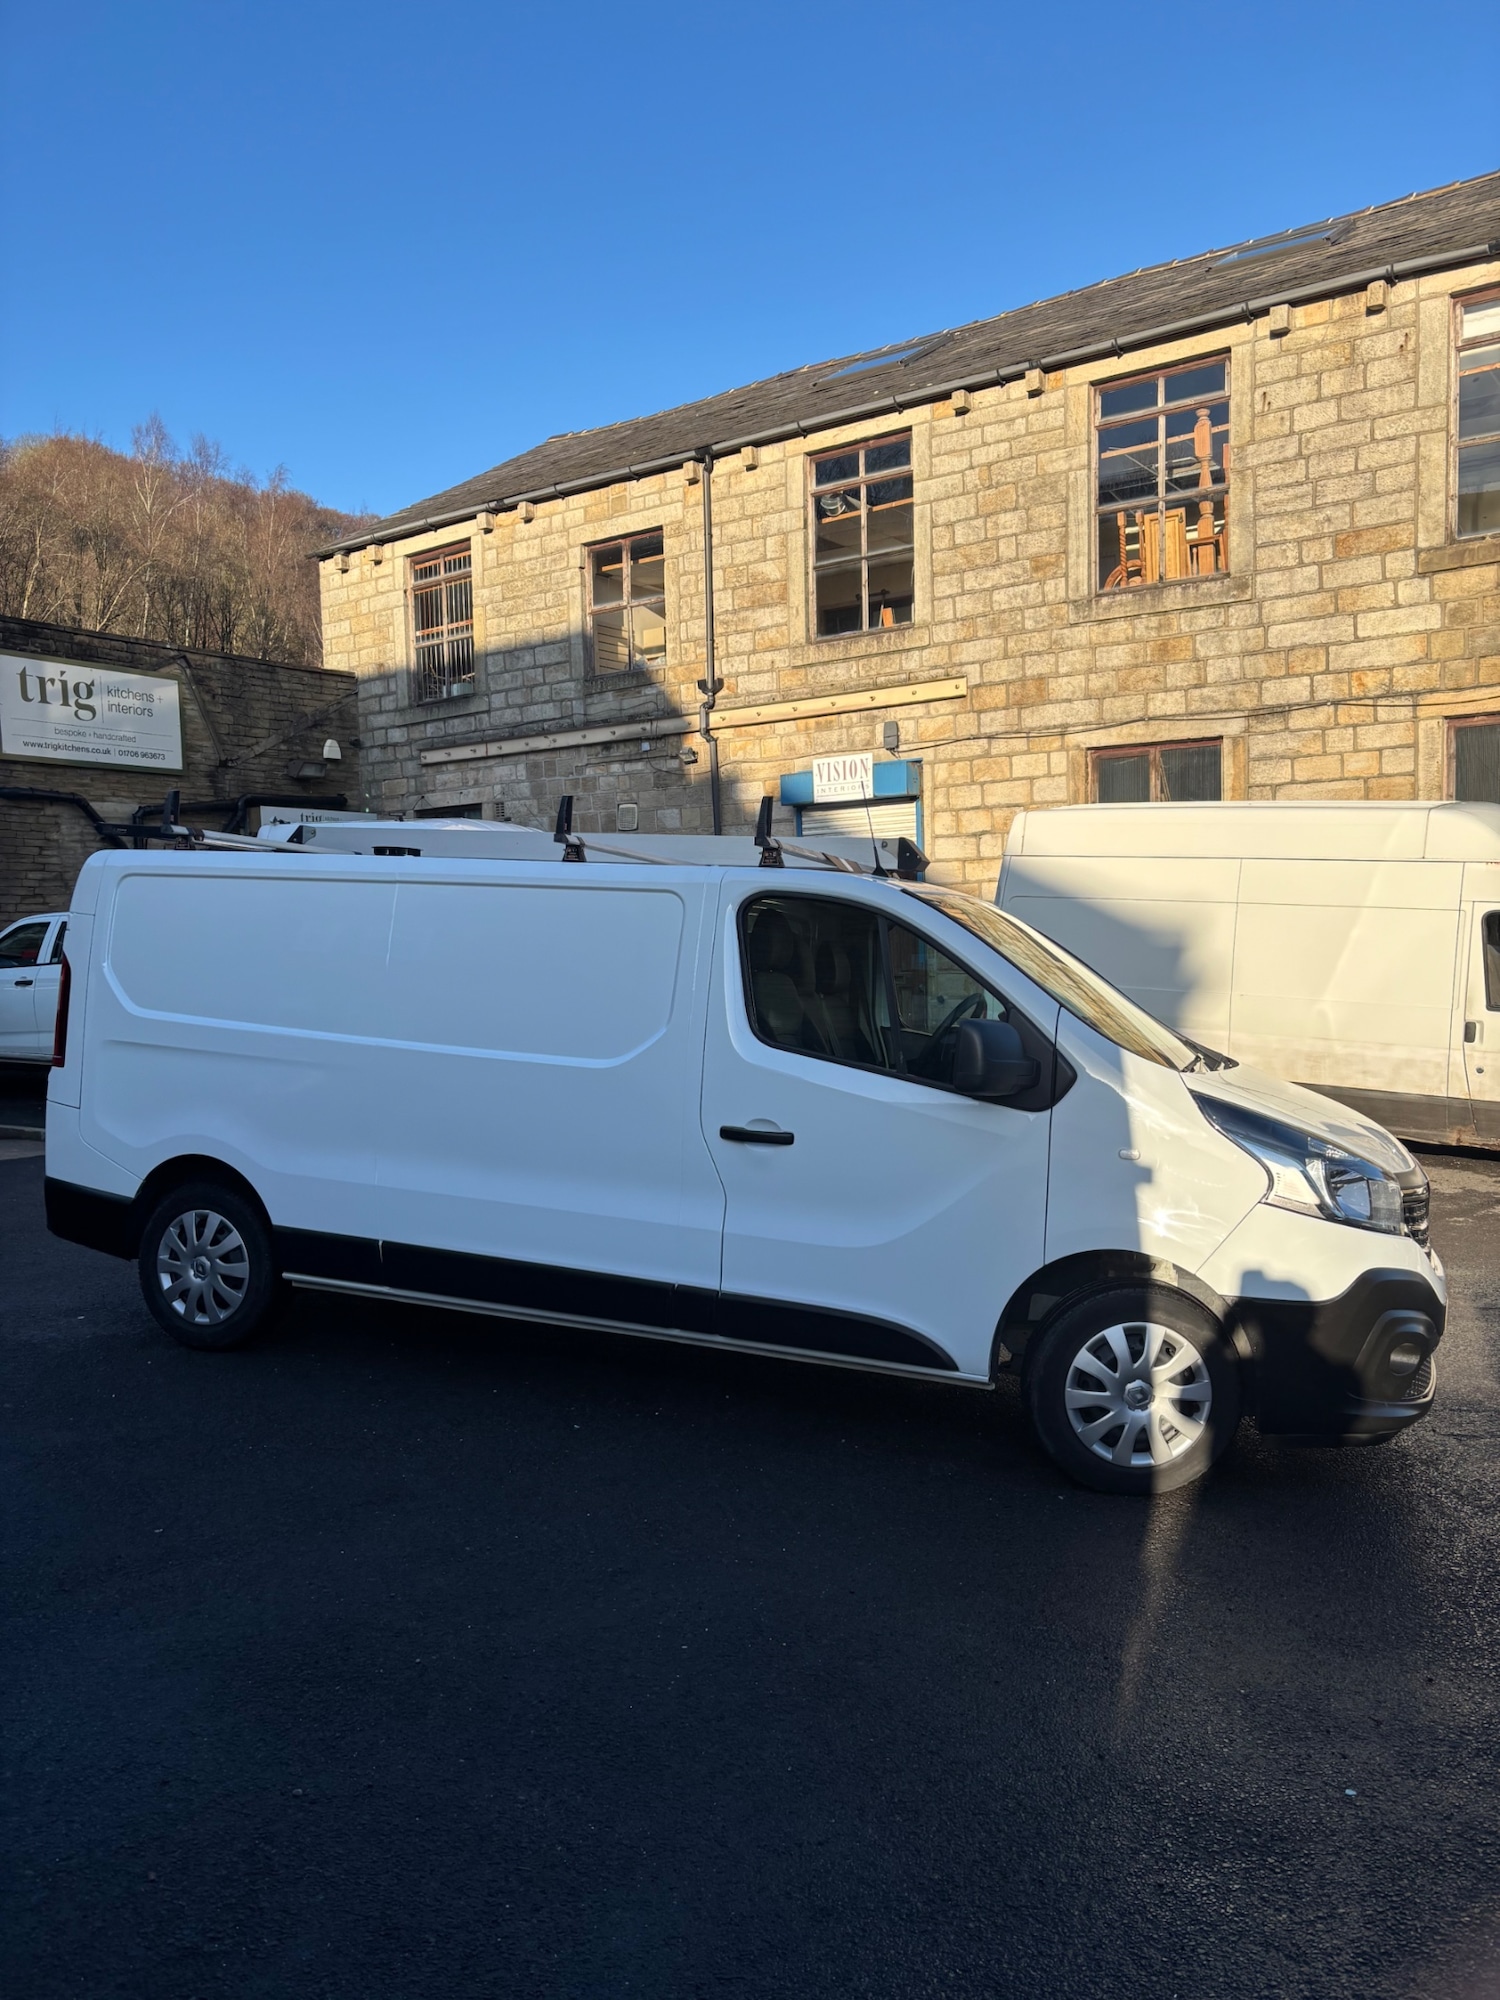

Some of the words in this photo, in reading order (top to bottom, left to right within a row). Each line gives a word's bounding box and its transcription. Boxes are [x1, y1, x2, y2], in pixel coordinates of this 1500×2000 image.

[16, 666, 97, 721] trig
[107, 685, 154, 703] kitchens
[107, 702, 154, 717] interiors
[54, 727, 87, 739] bespoke
[93, 731, 137, 743] handcrafted
[22, 740, 111, 754] www.trigkitchens.co.uk
[817, 758, 869, 783] VISION
